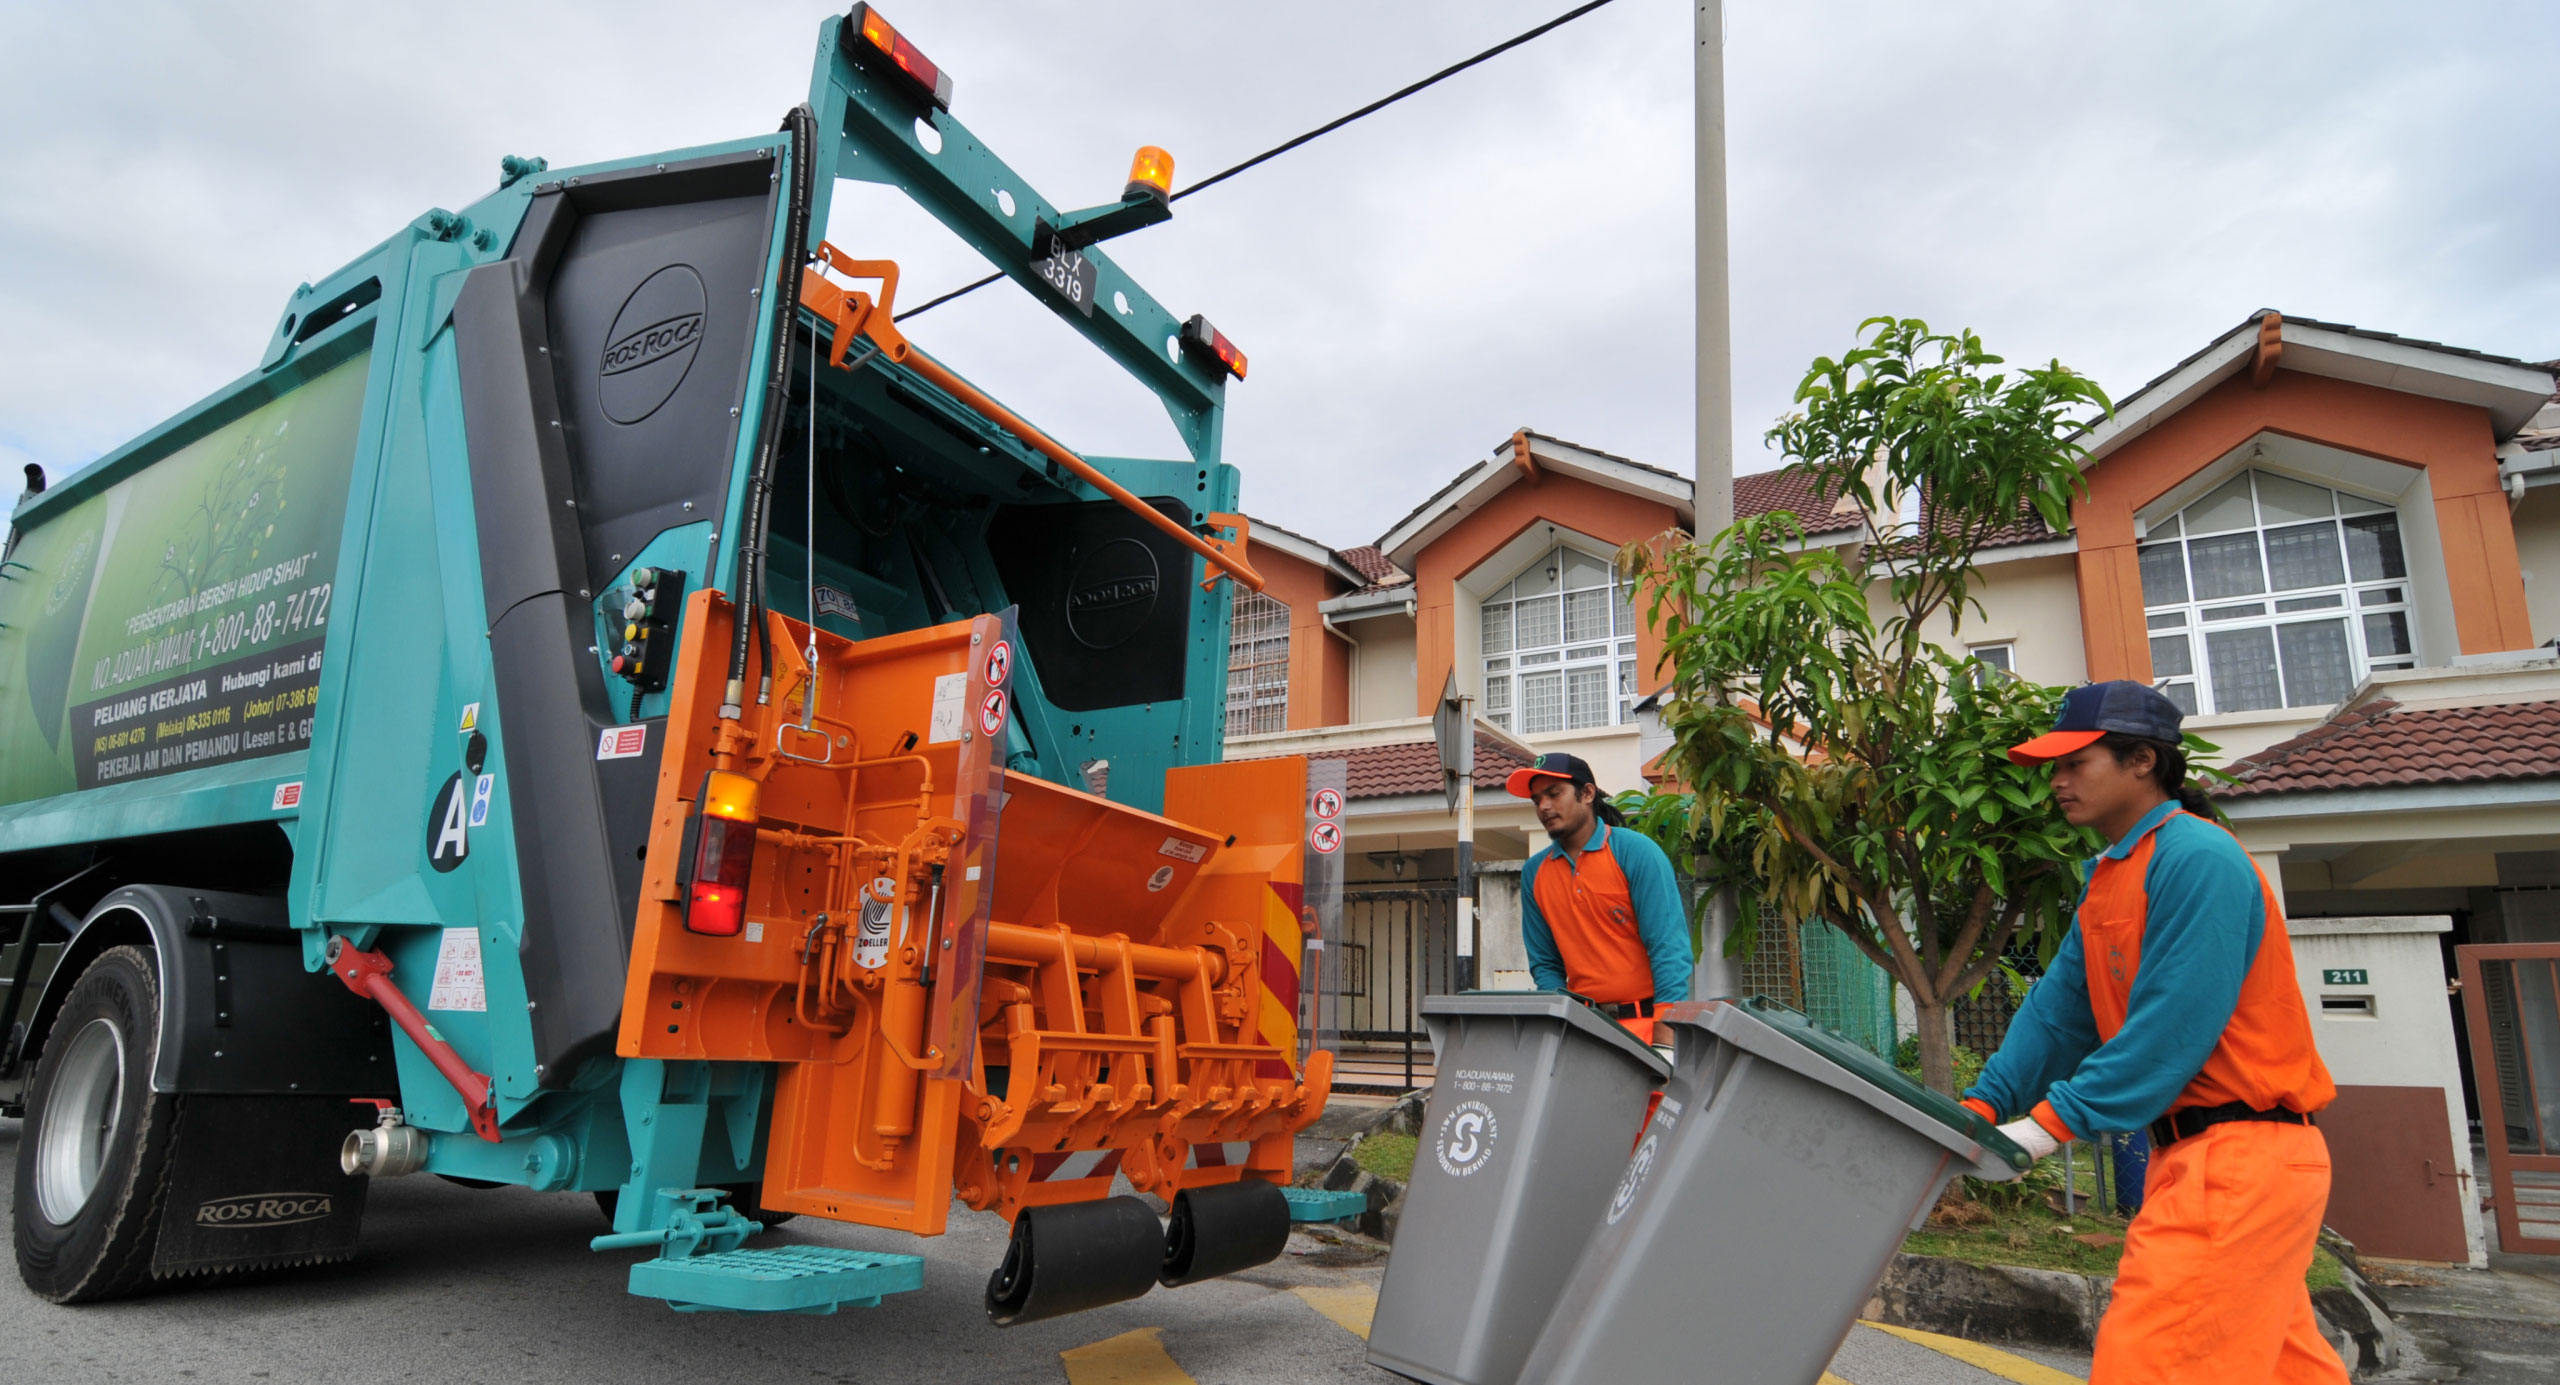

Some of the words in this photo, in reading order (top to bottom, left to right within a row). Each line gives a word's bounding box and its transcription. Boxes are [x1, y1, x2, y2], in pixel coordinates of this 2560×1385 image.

[1051, 233, 1082, 277] BLX
[1044, 258, 1082, 302] 3319
[602, 340, 641, 371] ROS
[641, 317, 702, 357] ROCA
[198, 579, 238, 612] BERSIH
[237, 567, 273, 598] HIDUP
[109, 642, 155, 686] ADUAN
[198, 582, 331, 660] 1-800-88-7472
[94, 695, 147, 727] PELUANG
[149, 679, 207, 712] KERJAYA
[222, 664, 271, 693] Hubungi
[273, 654, 305, 680] kami
[308, 650, 322, 671] di
[108, 730, 129, 750] 06-601
[129, 726, 146, 745] 4276
[156, 716, 186, 744] (Melaka)
[186, 709, 212, 732] 06-335
[212, 705, 231, 727] 0116
[243, 695, 275, 724] (Johor)
[275, 688, 306, 712] 07-386
[97, 753, 141, 781] PEKERJA
[143, 748, 160, 772] AM
[161, 744, 183, 768] DAN
[185, 732, 239, 763] PEMANDU
[242, 729, 276, 751] (Lesen
[278, 723, 286, 744] E
[288, 721, 297, 742] &
[433, 778, 467, 860] A
[858, 938, 888, 948] ZOELLER
[2331, 970, 2361, 983] 211
[1441, 1110, 1457, 1133] SWM
[1456, 1100, 1498, 1138] ENVIRONMENT
[1436, 1139, 1461, 1176] SENDIRIAN
[1462, 1148, 1492, 1176] BERHAD
[196, 1203, 254, 1223] ROS
[256, 1199, 331, 1219] ROCA
